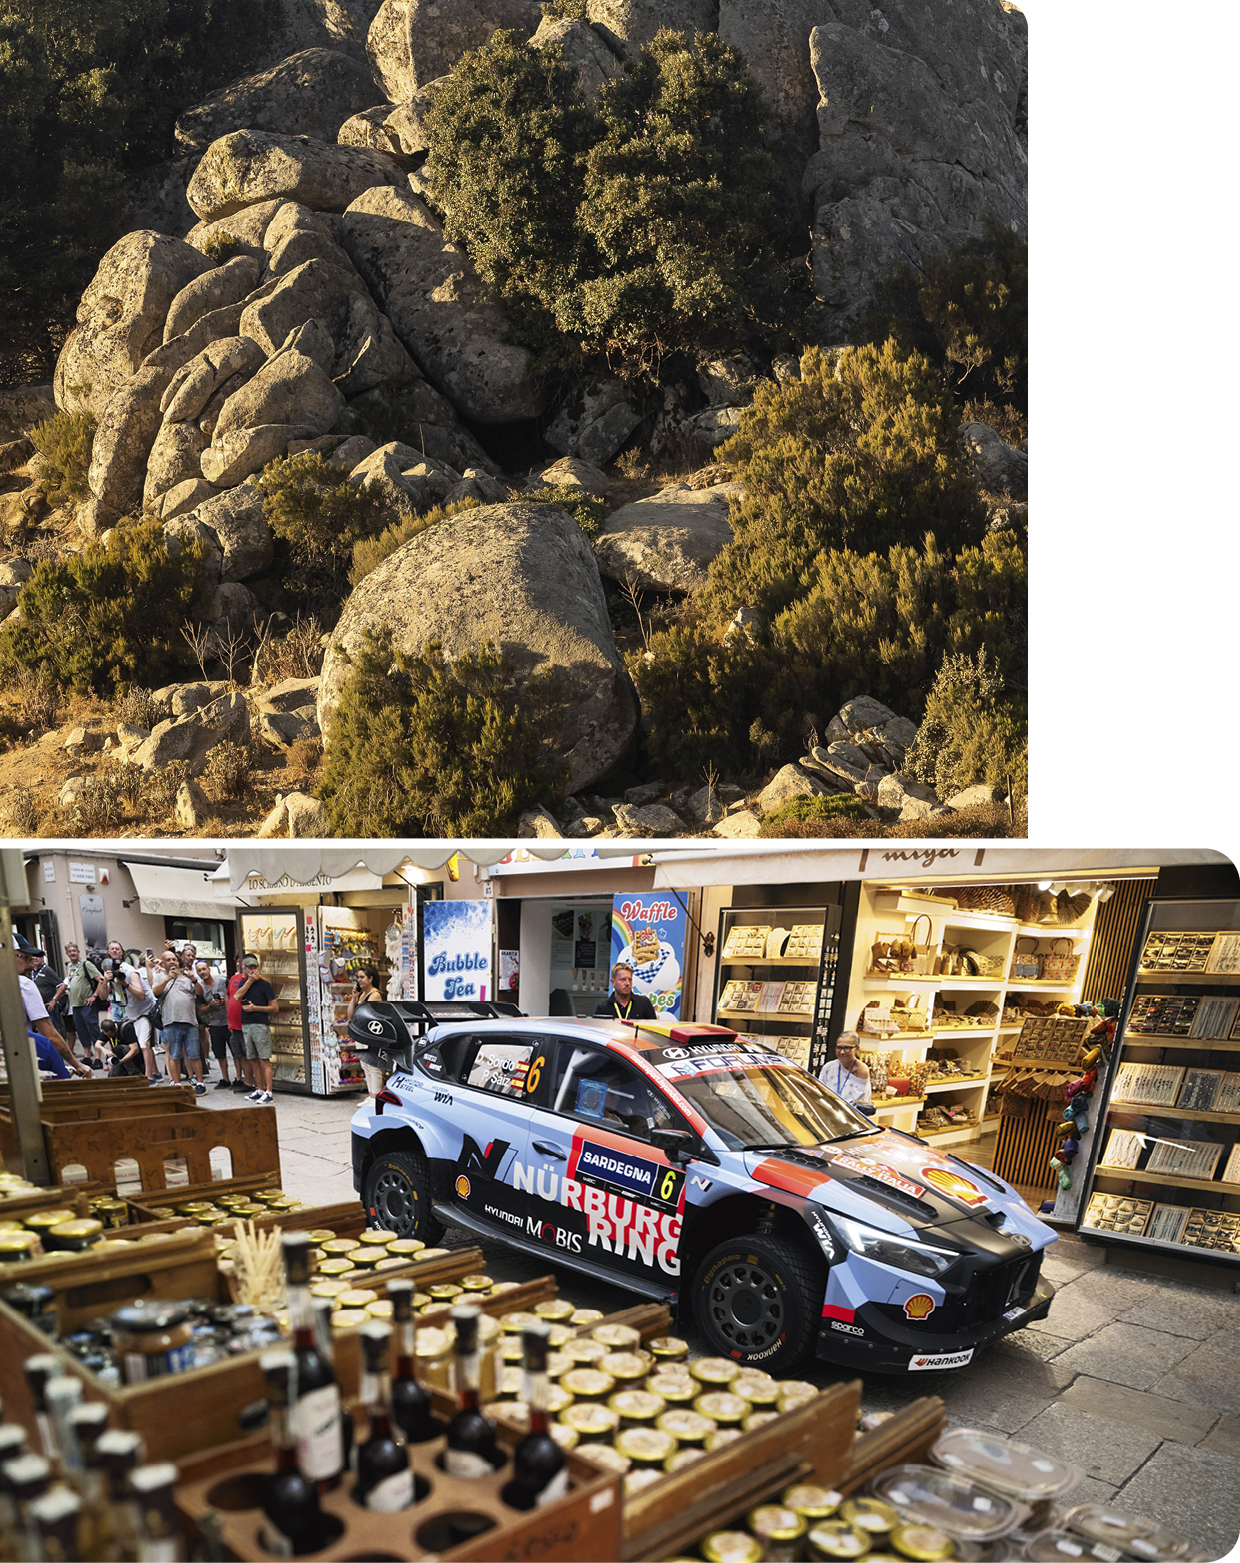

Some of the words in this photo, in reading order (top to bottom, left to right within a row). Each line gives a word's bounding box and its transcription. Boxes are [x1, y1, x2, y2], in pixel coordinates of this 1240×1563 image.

[248, 879, 258, 890] LO
[621, 900, 677, 922] Waffle
[427, 950, 488, 977] Bubble
[443, 976, 475, 1000] Tea
[474, 1051, 485, 1064] D.
[486, 1053, 516, 1072] Sordo
[688, 1043, 744, 1055] HYUNDAI
[481, 1069, 490, 1082] P.
[490, 1071, 511, 1087] Sáiz
[526, 1055, 546, 1093] 6
[630, 1054, 692, 1117] motorsport.hyundai.com
[399, 1083, 415, 1093] STEEL
[434, 1091, 454, 1106] WIA
[582, 1151, 652, 1184] SARDEGNA
[660, 1170, 677, 1200] 6
[838, 1156, 877, 1173] RALLY
[878, 1173, 917, 1194] ITALIA
[513, 1160, 684, 1241] NÜRBURG
[484, 1204, 524, 1228] HYUNDAI
[526, 1216, 583, 1253] MOBIS
[588, 1213, 682, 1277] RING
[813, 1223, 836, 1260] WIA
[830, 1320, 865, 1336] sparco
